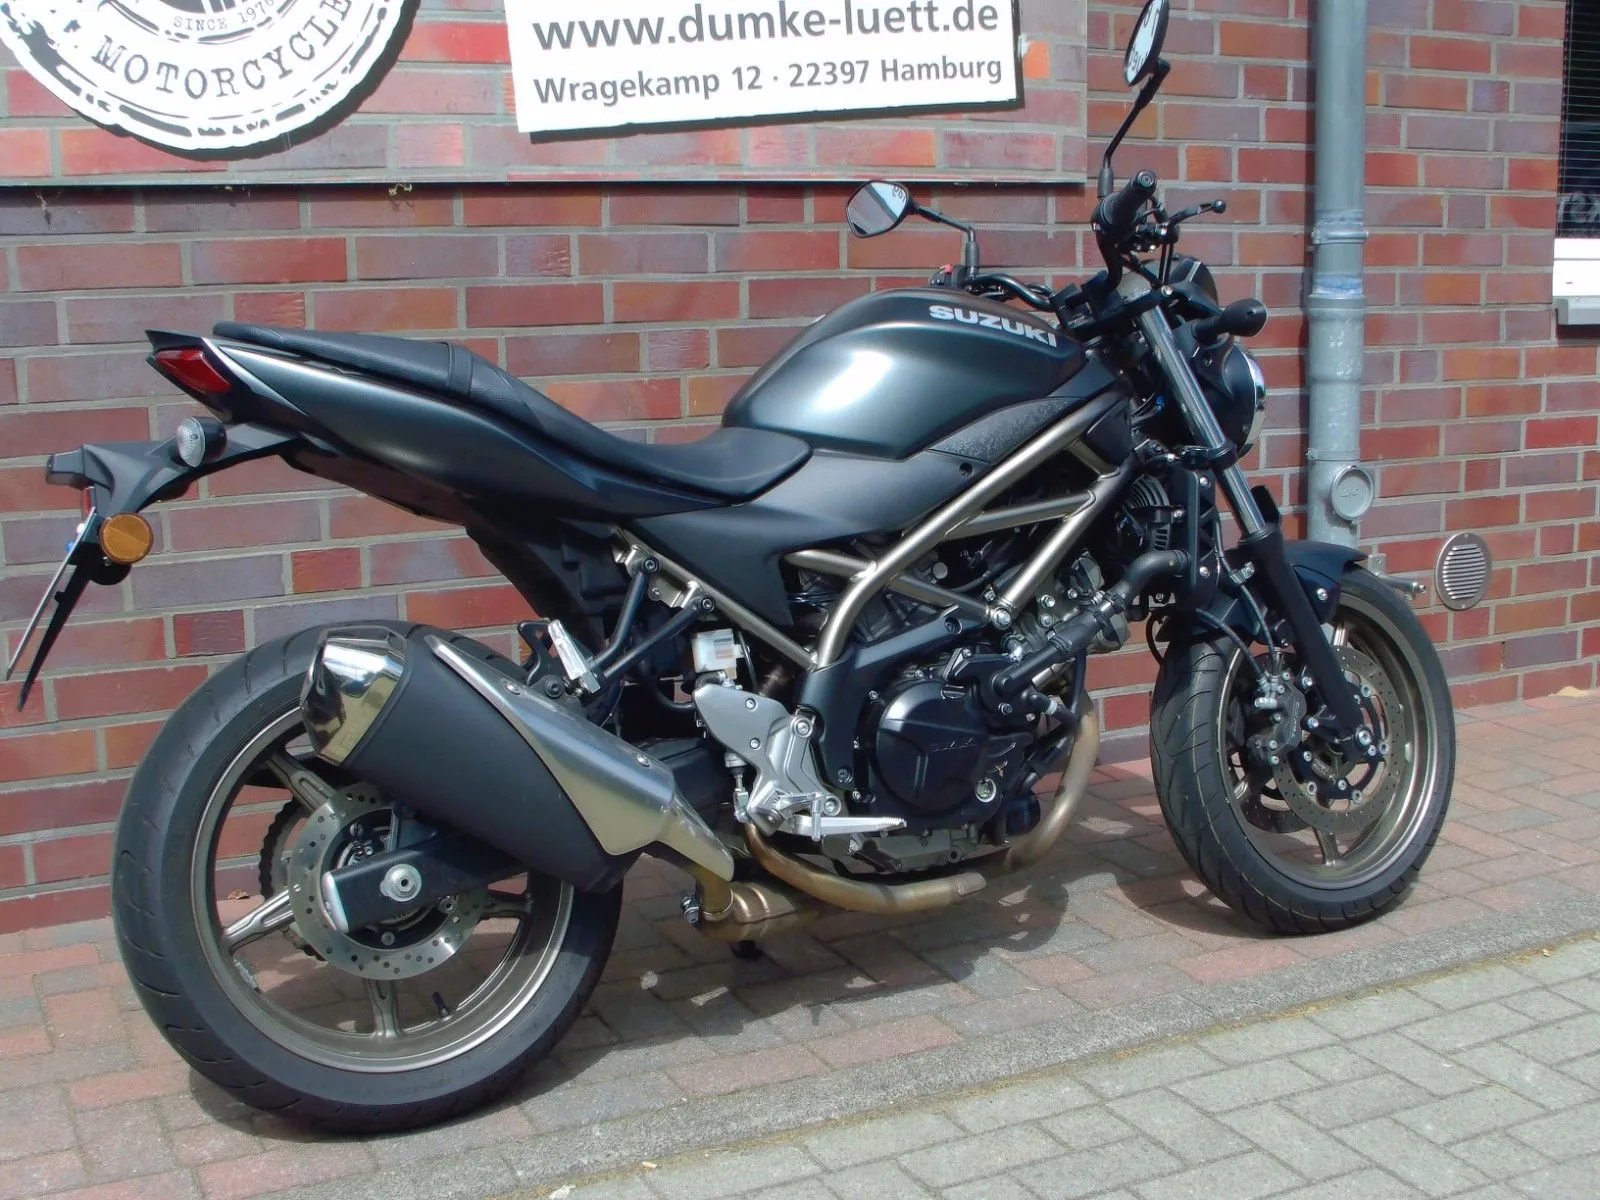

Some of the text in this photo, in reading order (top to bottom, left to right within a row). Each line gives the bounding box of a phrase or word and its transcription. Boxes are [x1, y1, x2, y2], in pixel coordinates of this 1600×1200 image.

[174, 15, 227, 31] SINCE
[532, 0, 998, 50] www.dumke-luett.de
[533, 55, 1002, 107] Wragekamp 12 22397 Hamburg
[929, 305, 1057, 347] SUZUKI
